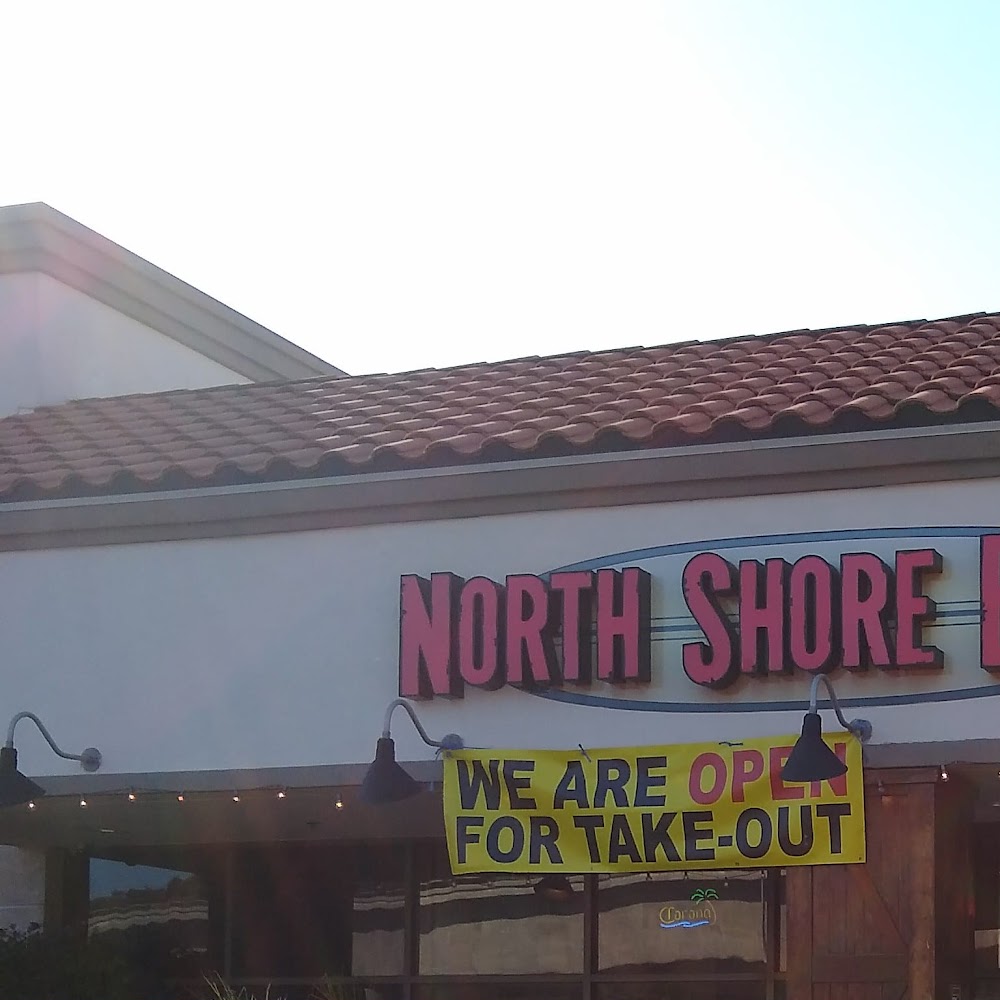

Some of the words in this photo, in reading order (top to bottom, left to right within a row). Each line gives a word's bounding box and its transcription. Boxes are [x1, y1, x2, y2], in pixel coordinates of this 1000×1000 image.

[399, 567, 650, 700] NORTH
[682, 548, 944, 689] SHORE
[457, 759, 537, 811] WE
[553, 756, 667, 809] ARE
[456, 816, 560, 865] FOR
[574, 803, 852, 864] TAKE-OUT
